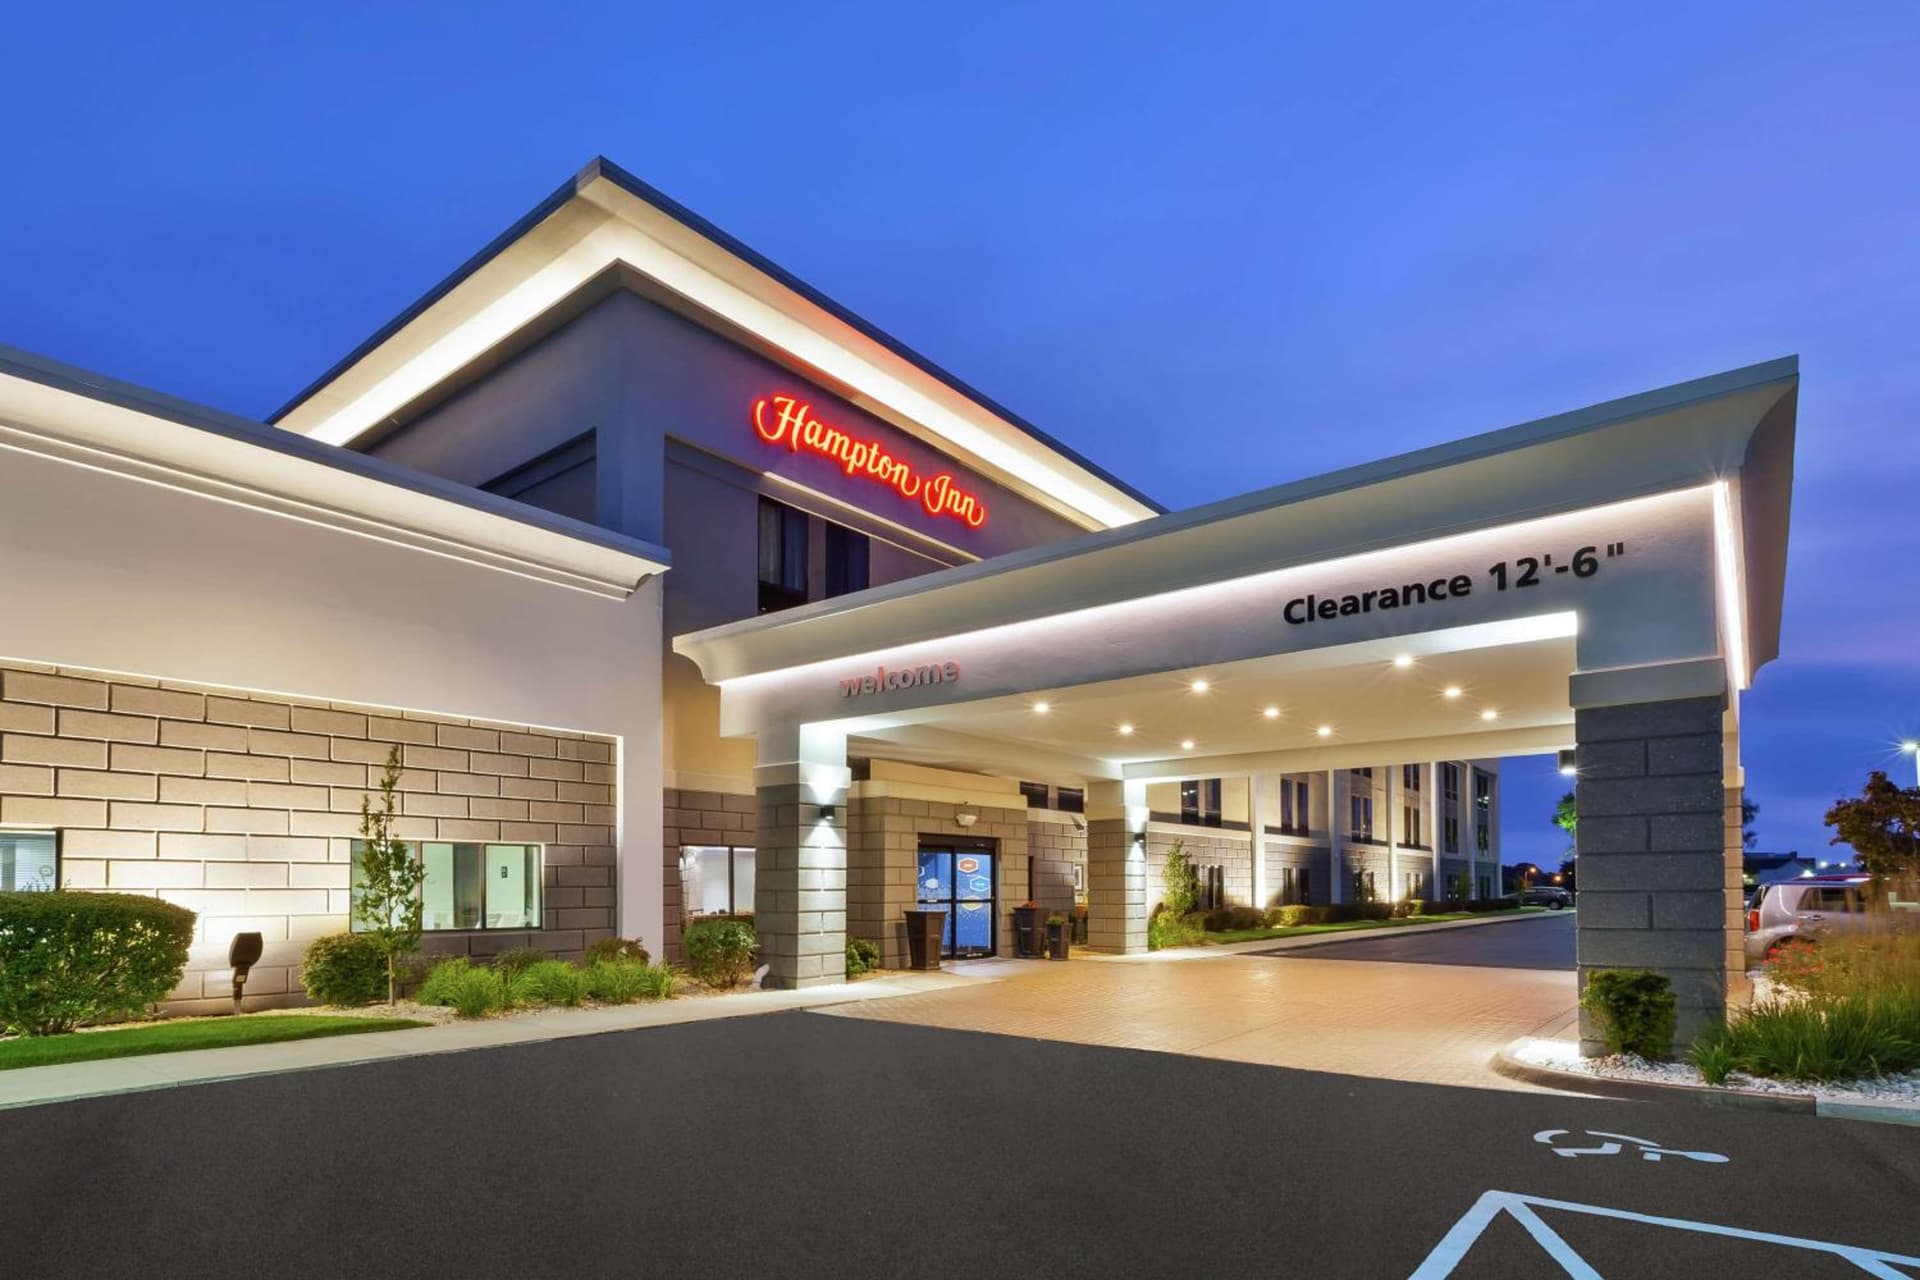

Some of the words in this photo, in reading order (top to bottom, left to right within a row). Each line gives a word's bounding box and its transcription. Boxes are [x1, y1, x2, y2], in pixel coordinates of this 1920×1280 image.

[755, 395, 921, 497] Hampton
[924, 474, 985, 527] Inn
[1283, 573, 1472, 625] Clearance
[840, 661, 960, 698] welcome
